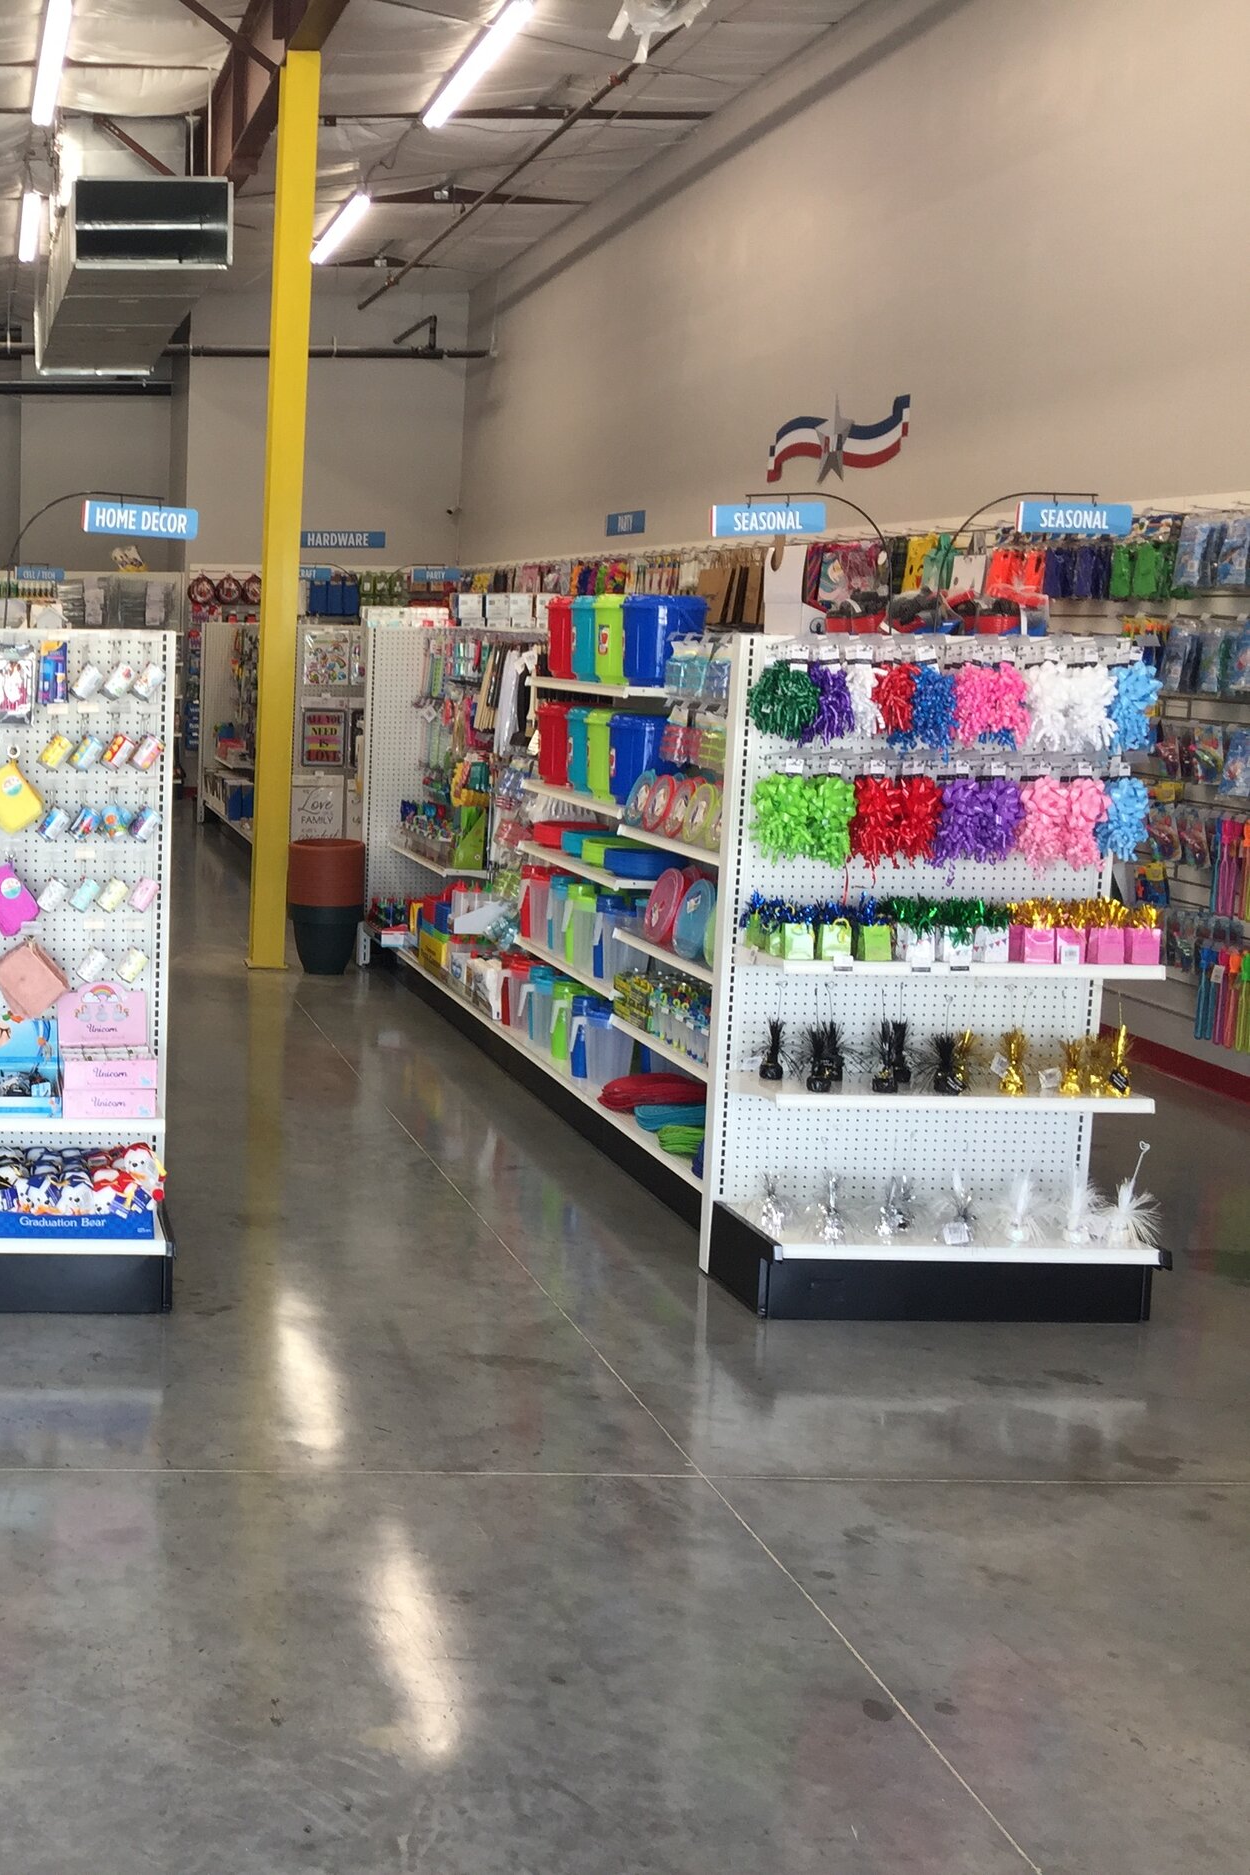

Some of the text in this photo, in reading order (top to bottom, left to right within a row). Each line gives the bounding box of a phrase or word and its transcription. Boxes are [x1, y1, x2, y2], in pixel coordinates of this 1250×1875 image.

[95, 507, 188, 534] HOME DECOR
[733, 510, 804, 532] SEASONAL
[1039, 509, 1109, 529] SEASONAL
[307, 533, 370, 546] HARDWARE
[300, 568, 317, 579] RAFT
[426, 570, 446, 580] PARTY
[311, 727, 338, 736] NEED
[306, 750, 342, 762] LOVE
[297, 787, 334, 815] Love
[301, 816, 334, 825] FAMILY
[86, 1023, 118, 1033] Unicorn
[92, 1067, 128, 1078] Unicorn
[91, 1097, 127, 1108] Unicorn
[19, 1216, 107, 1228] Graduation Bear
